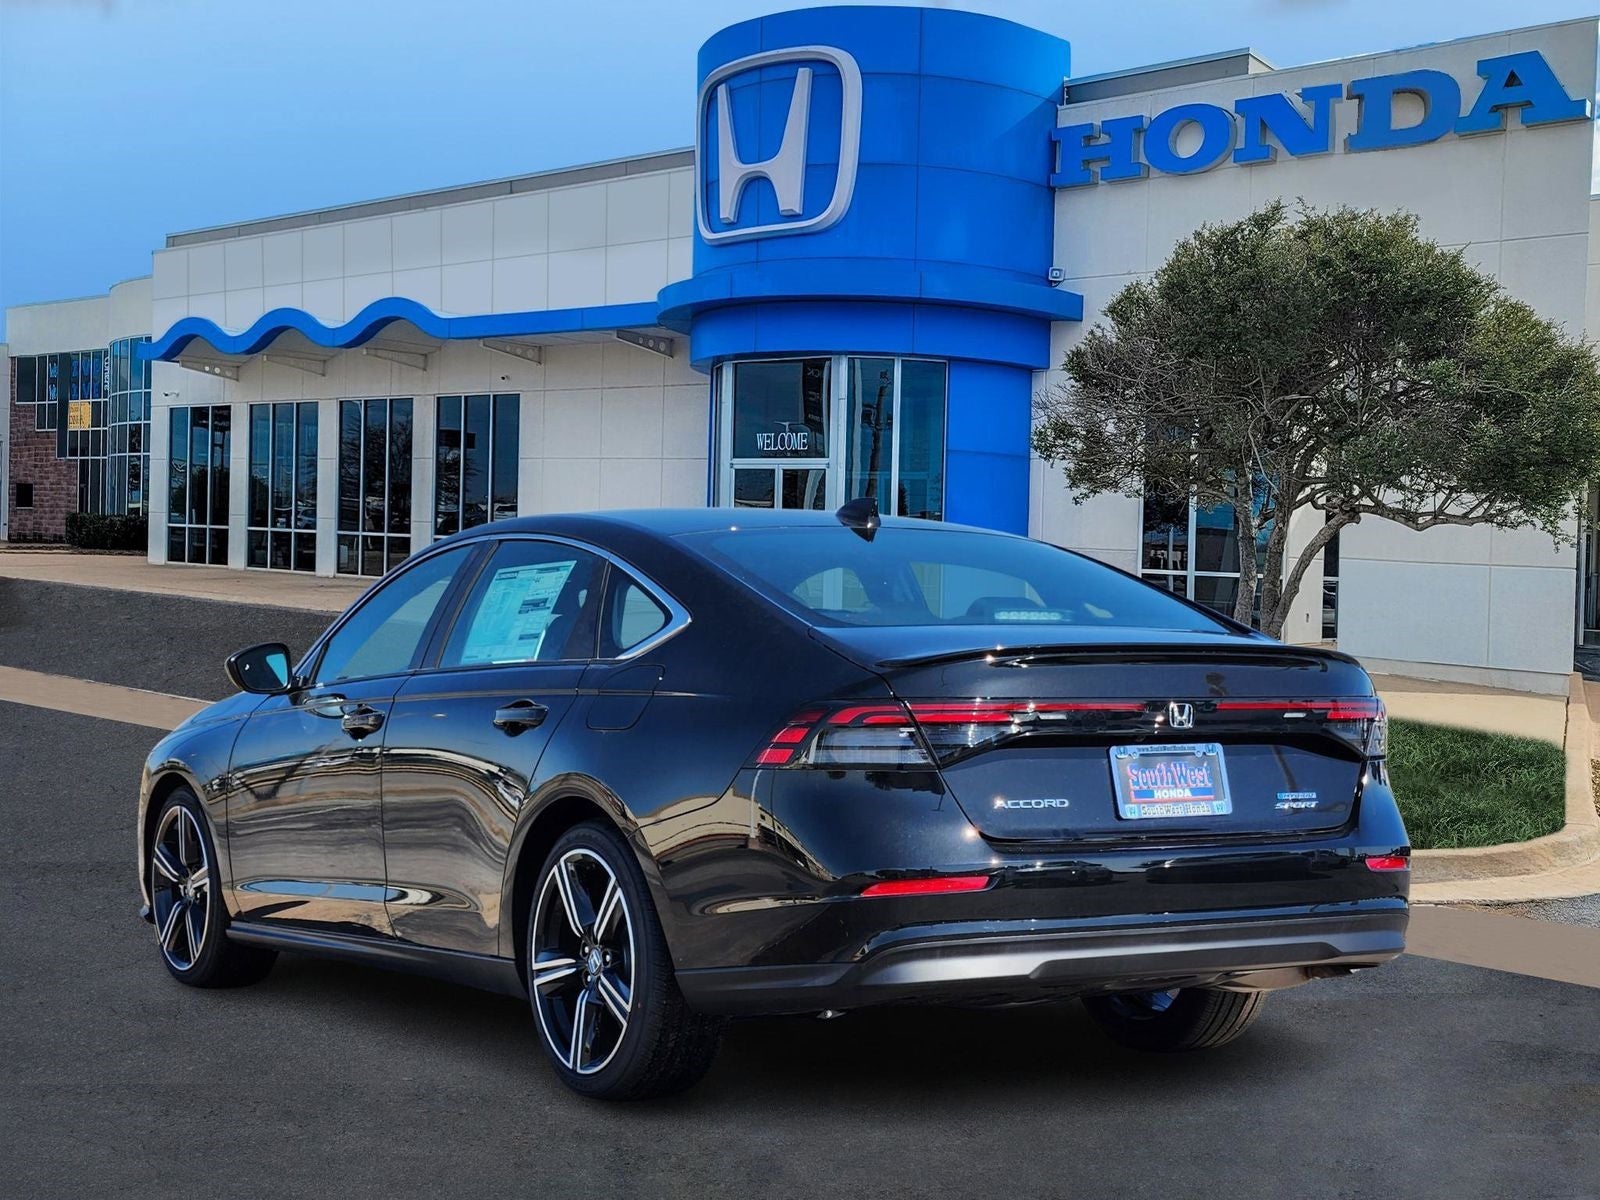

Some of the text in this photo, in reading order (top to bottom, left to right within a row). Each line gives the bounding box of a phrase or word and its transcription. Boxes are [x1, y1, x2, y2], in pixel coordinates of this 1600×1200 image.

[1051, 50, 1591, 187] HONDA
[756, 432, 808, 451] WELCOME
[1154, 788, 1192, 799] HONDA
[993, 798, 1069, 809] ACCORD
[1186, 803, 1211, 814] Honda
[1274, 801, 1319, 809] SPORT
